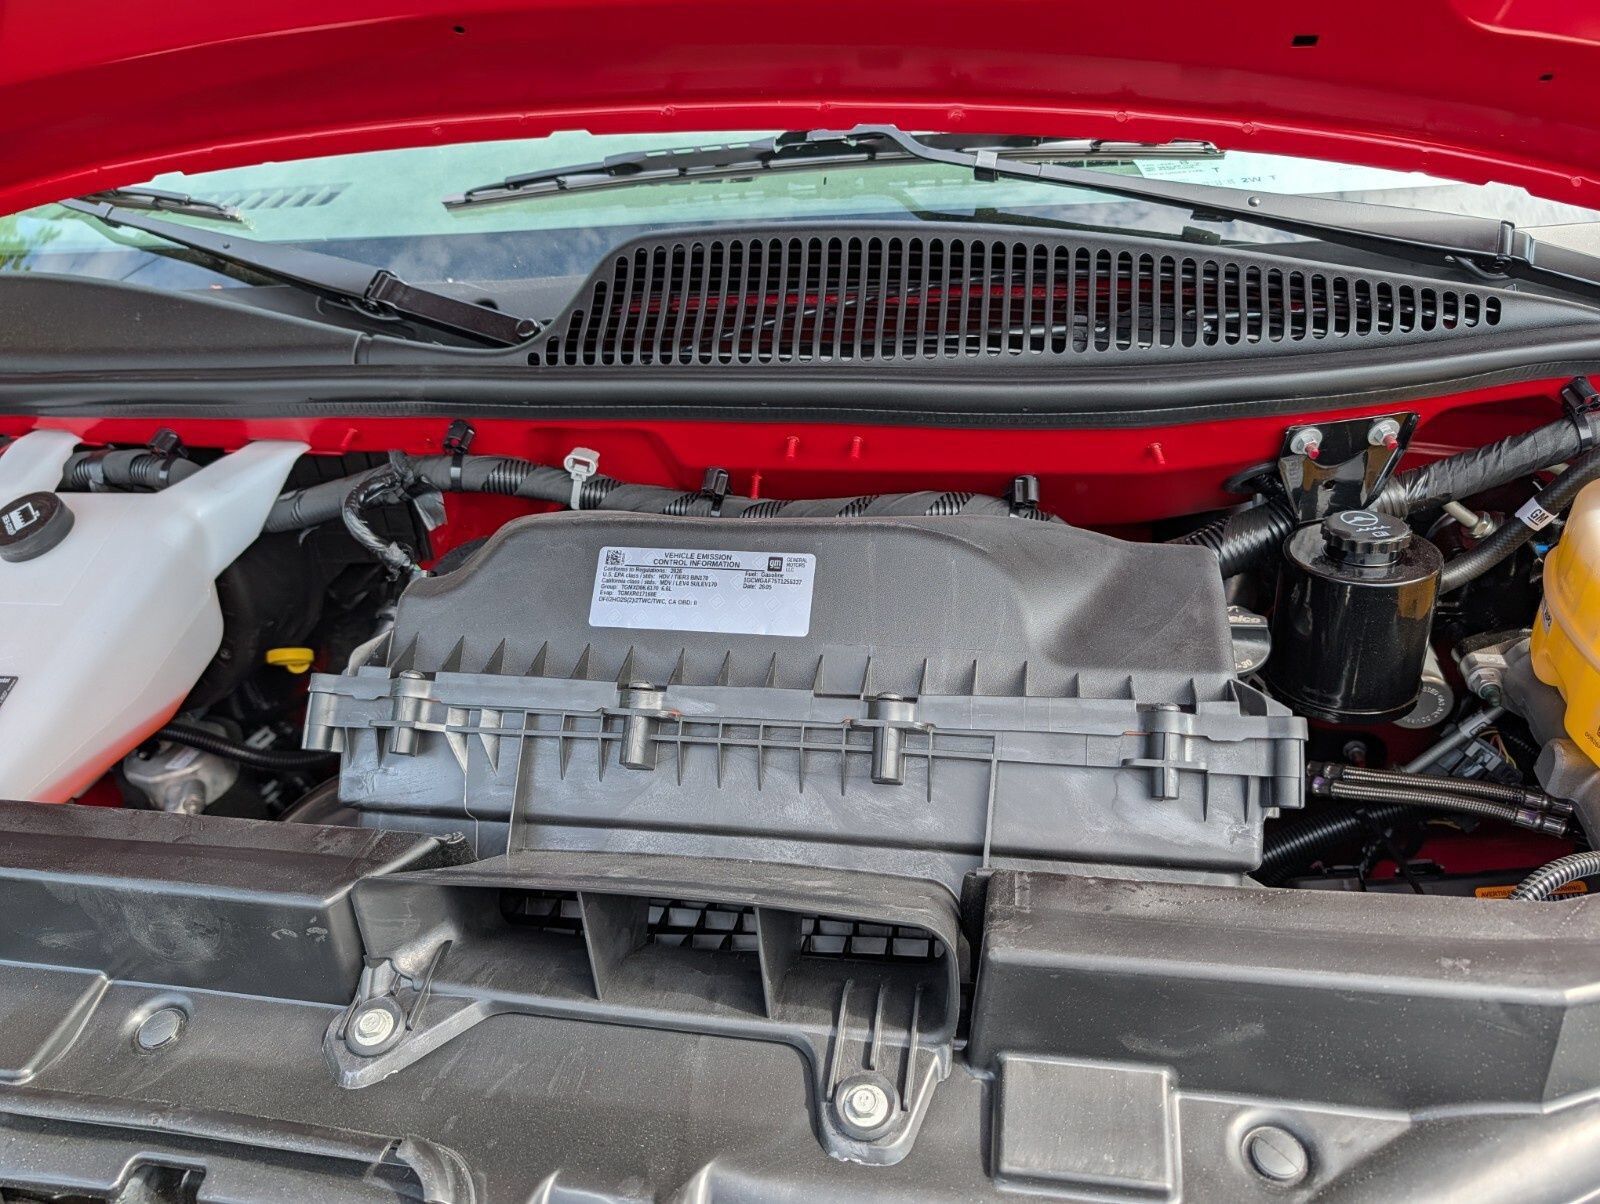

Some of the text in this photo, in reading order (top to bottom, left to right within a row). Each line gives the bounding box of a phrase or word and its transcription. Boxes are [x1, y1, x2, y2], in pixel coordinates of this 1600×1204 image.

[1530, 508, 1549, 524] GM
[664, 552, 733, 561] VEHICLE EMISSION
[689, 560, 741, 568] INFORMATION
[769, 558, 782, 570] gm
